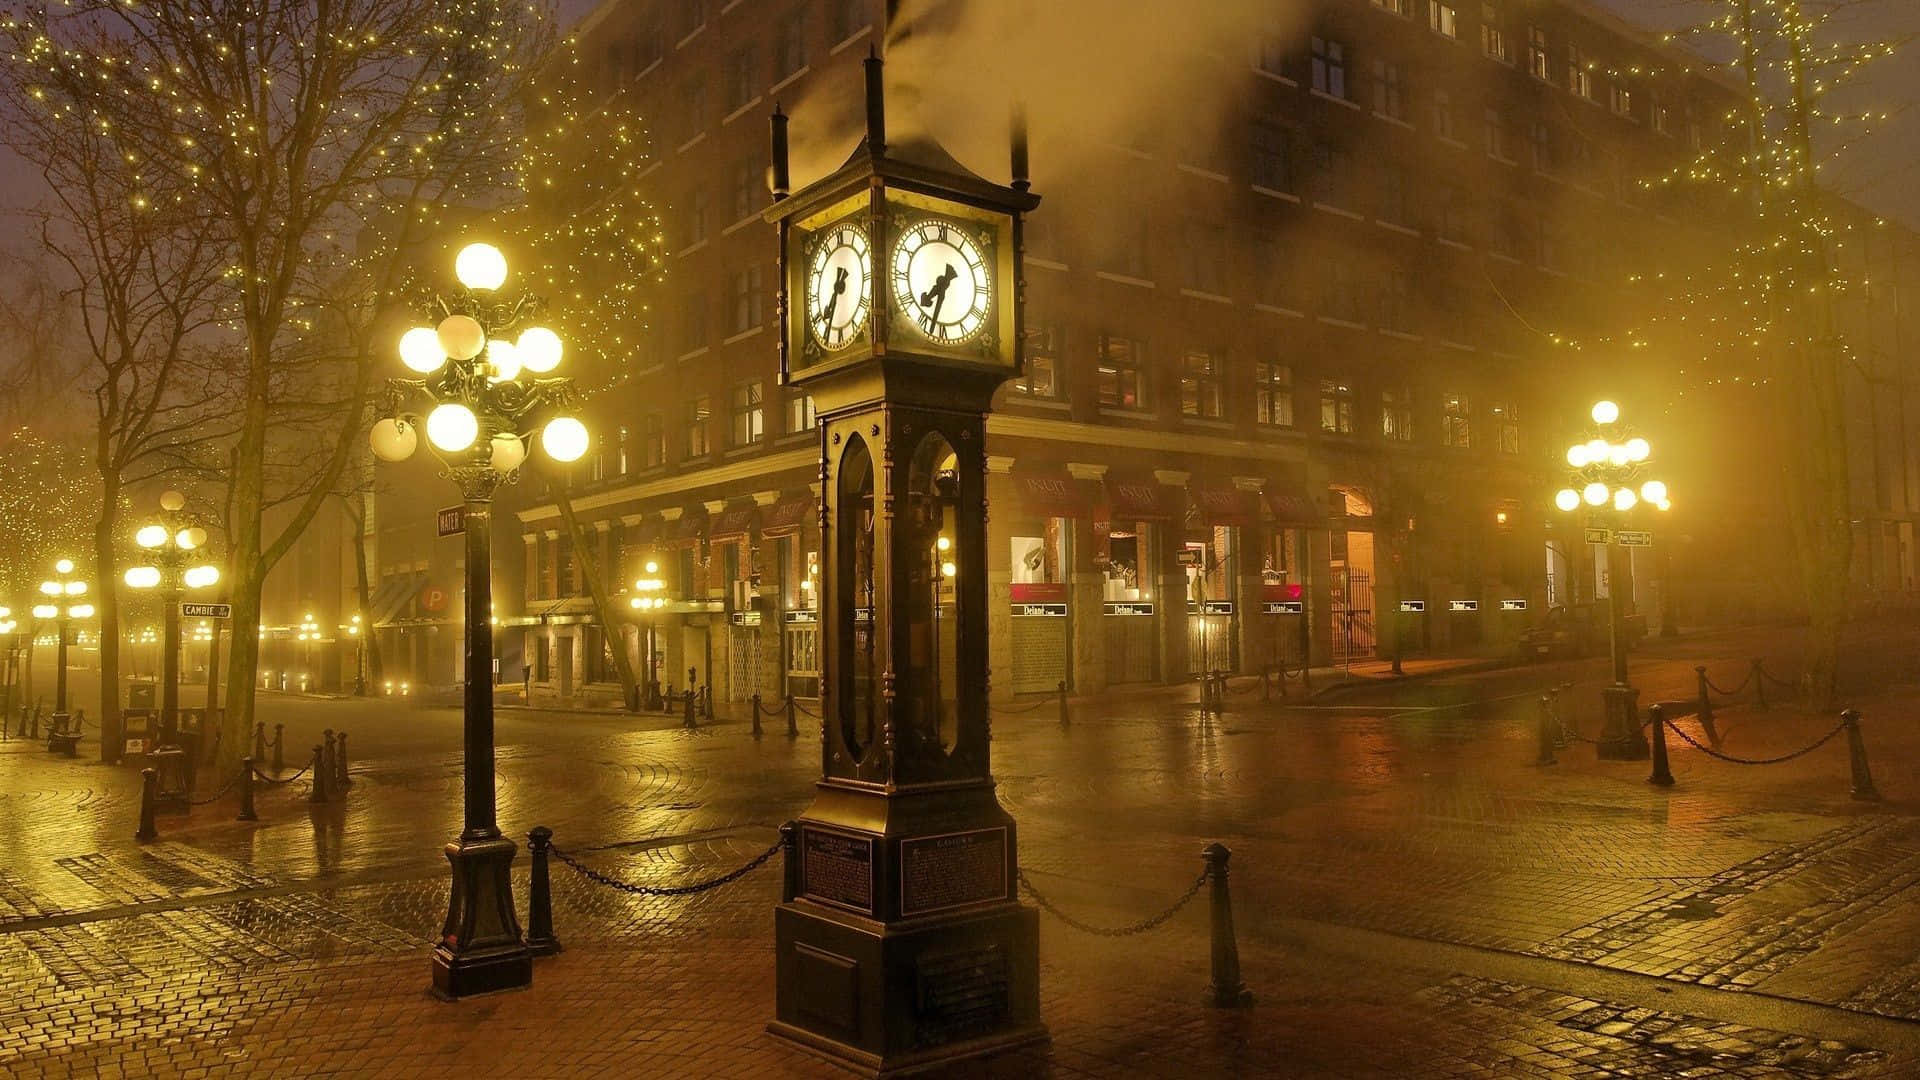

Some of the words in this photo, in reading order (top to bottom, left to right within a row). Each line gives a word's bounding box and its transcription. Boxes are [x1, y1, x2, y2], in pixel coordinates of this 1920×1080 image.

[440, 512, 459, 532] WATER
[430, 591, 443, 608] P
[185, 606, 214, 616] CAMBIE
